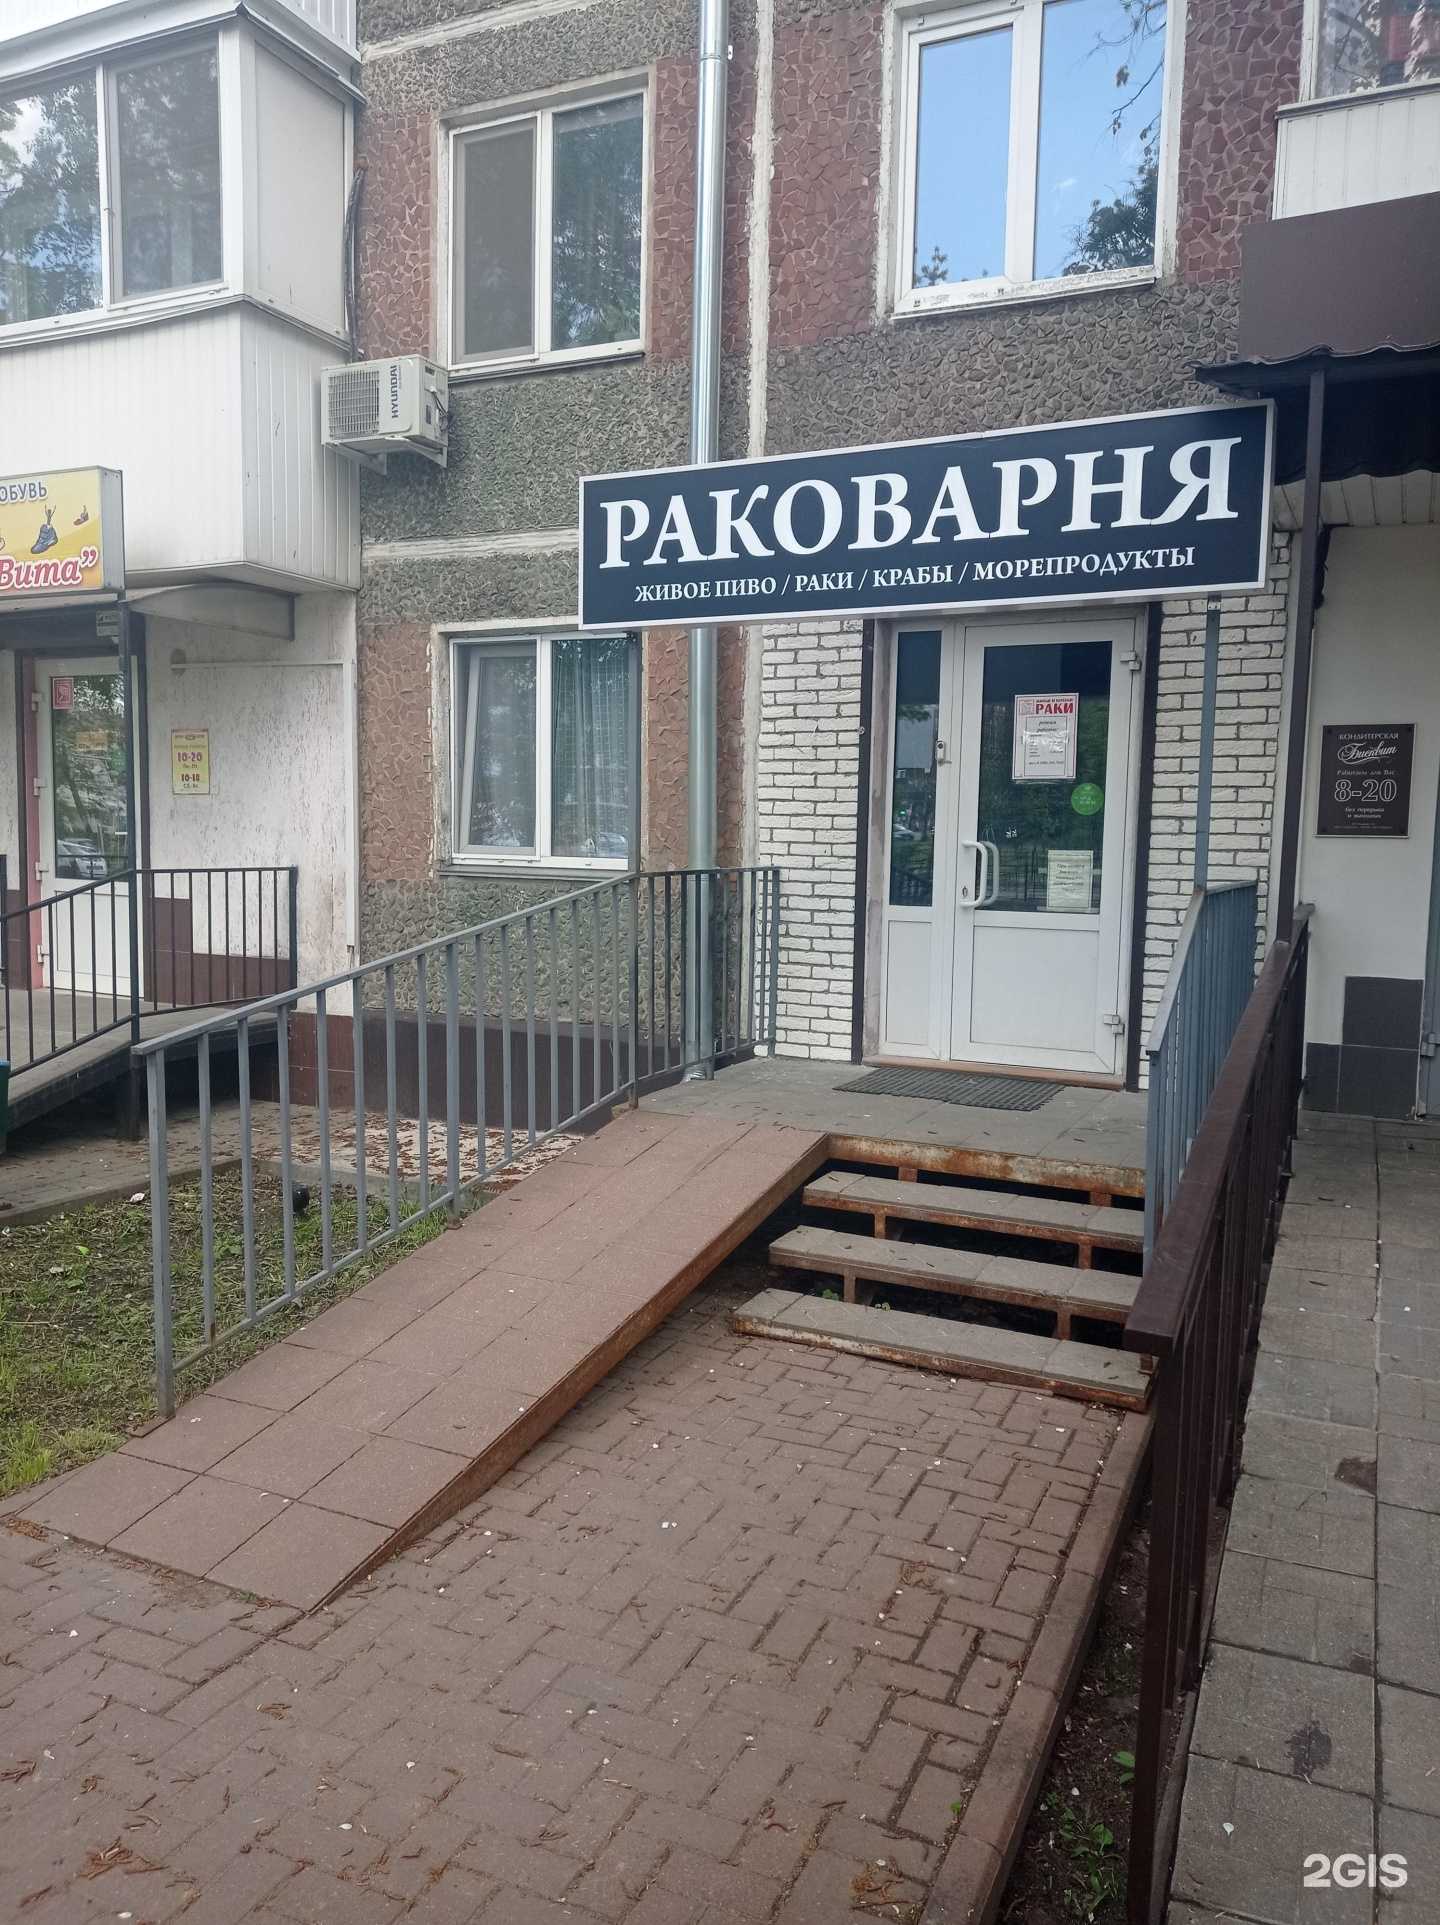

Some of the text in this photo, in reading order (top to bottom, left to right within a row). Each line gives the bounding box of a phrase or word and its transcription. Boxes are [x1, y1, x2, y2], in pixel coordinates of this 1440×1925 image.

[390, 365, 399, 419] HYUNDAI
[0, 481, 47, 502] ОБУВЬ
[599, 437, 1242, 569] РАКОВАРНЯ
[634, 581, 712, 602] ЖИВОЕ
[714, 576, 777, 598] ПИВО
[794, 571, 854, 593] РАКИ
[872, 564, 954, 588] КРАБЫ
[972, 546, 1196, 581] МОРЕПРОДУКТЫ
[1035, 702, 1074, 715] РАКИ
[1334, 779, 1398, 802] 8-20
